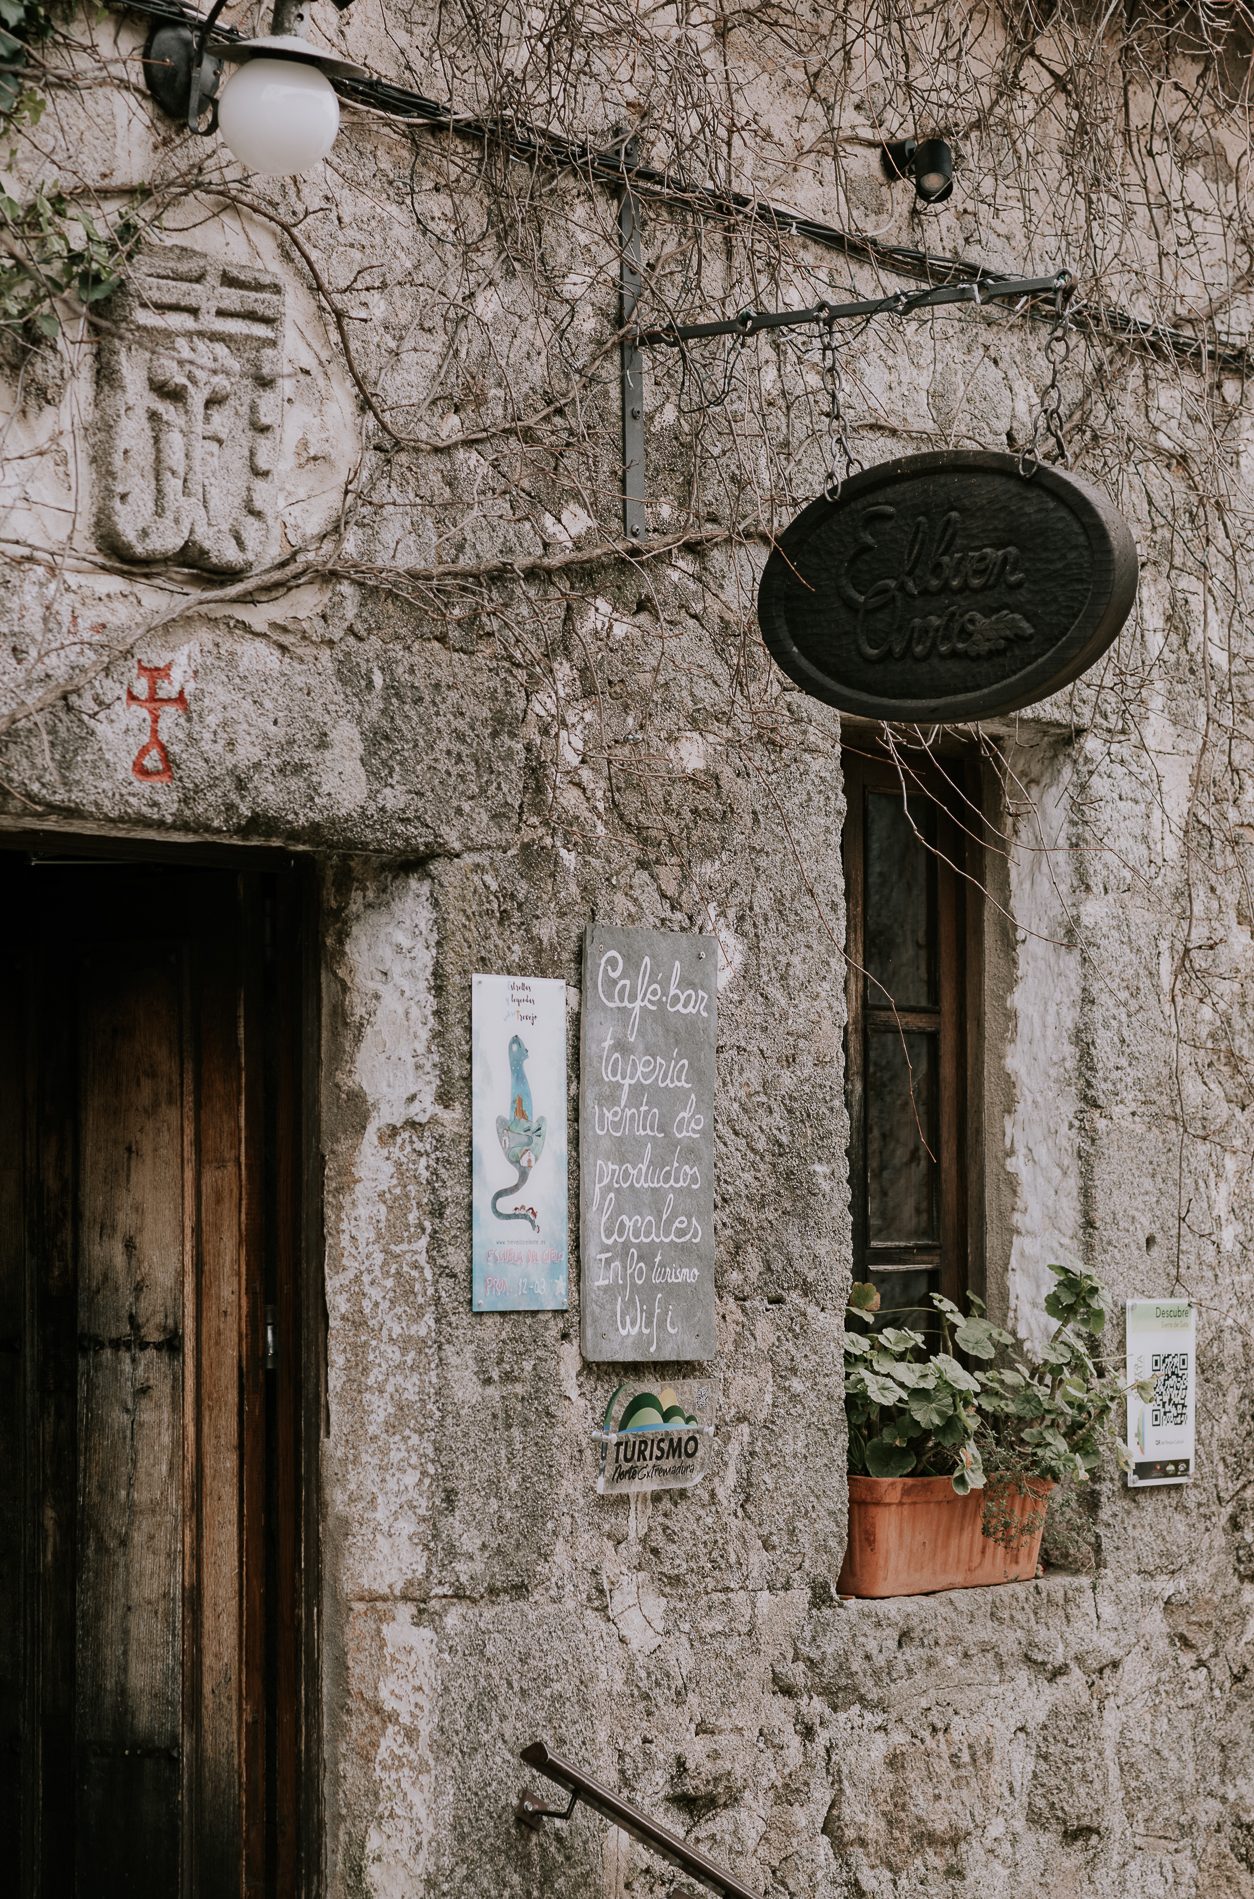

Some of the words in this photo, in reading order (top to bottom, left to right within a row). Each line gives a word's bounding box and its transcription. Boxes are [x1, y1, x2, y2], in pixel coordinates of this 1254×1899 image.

[594, 1094, 665, 1137] venta
[673, 1093, 704, 1138] de
[592, 1142, 701, 1212] productos
[600, 1193, 702, 1244] locales
[594, 1248, 646, 1301] Info
[651, 1250, 700, 1284] turismo
[617, 1294, 678, 1352] Wifi
[1155, 1306, 1189, 1318] Descubre
[614, 1435, 699, 1463] TURISMO
